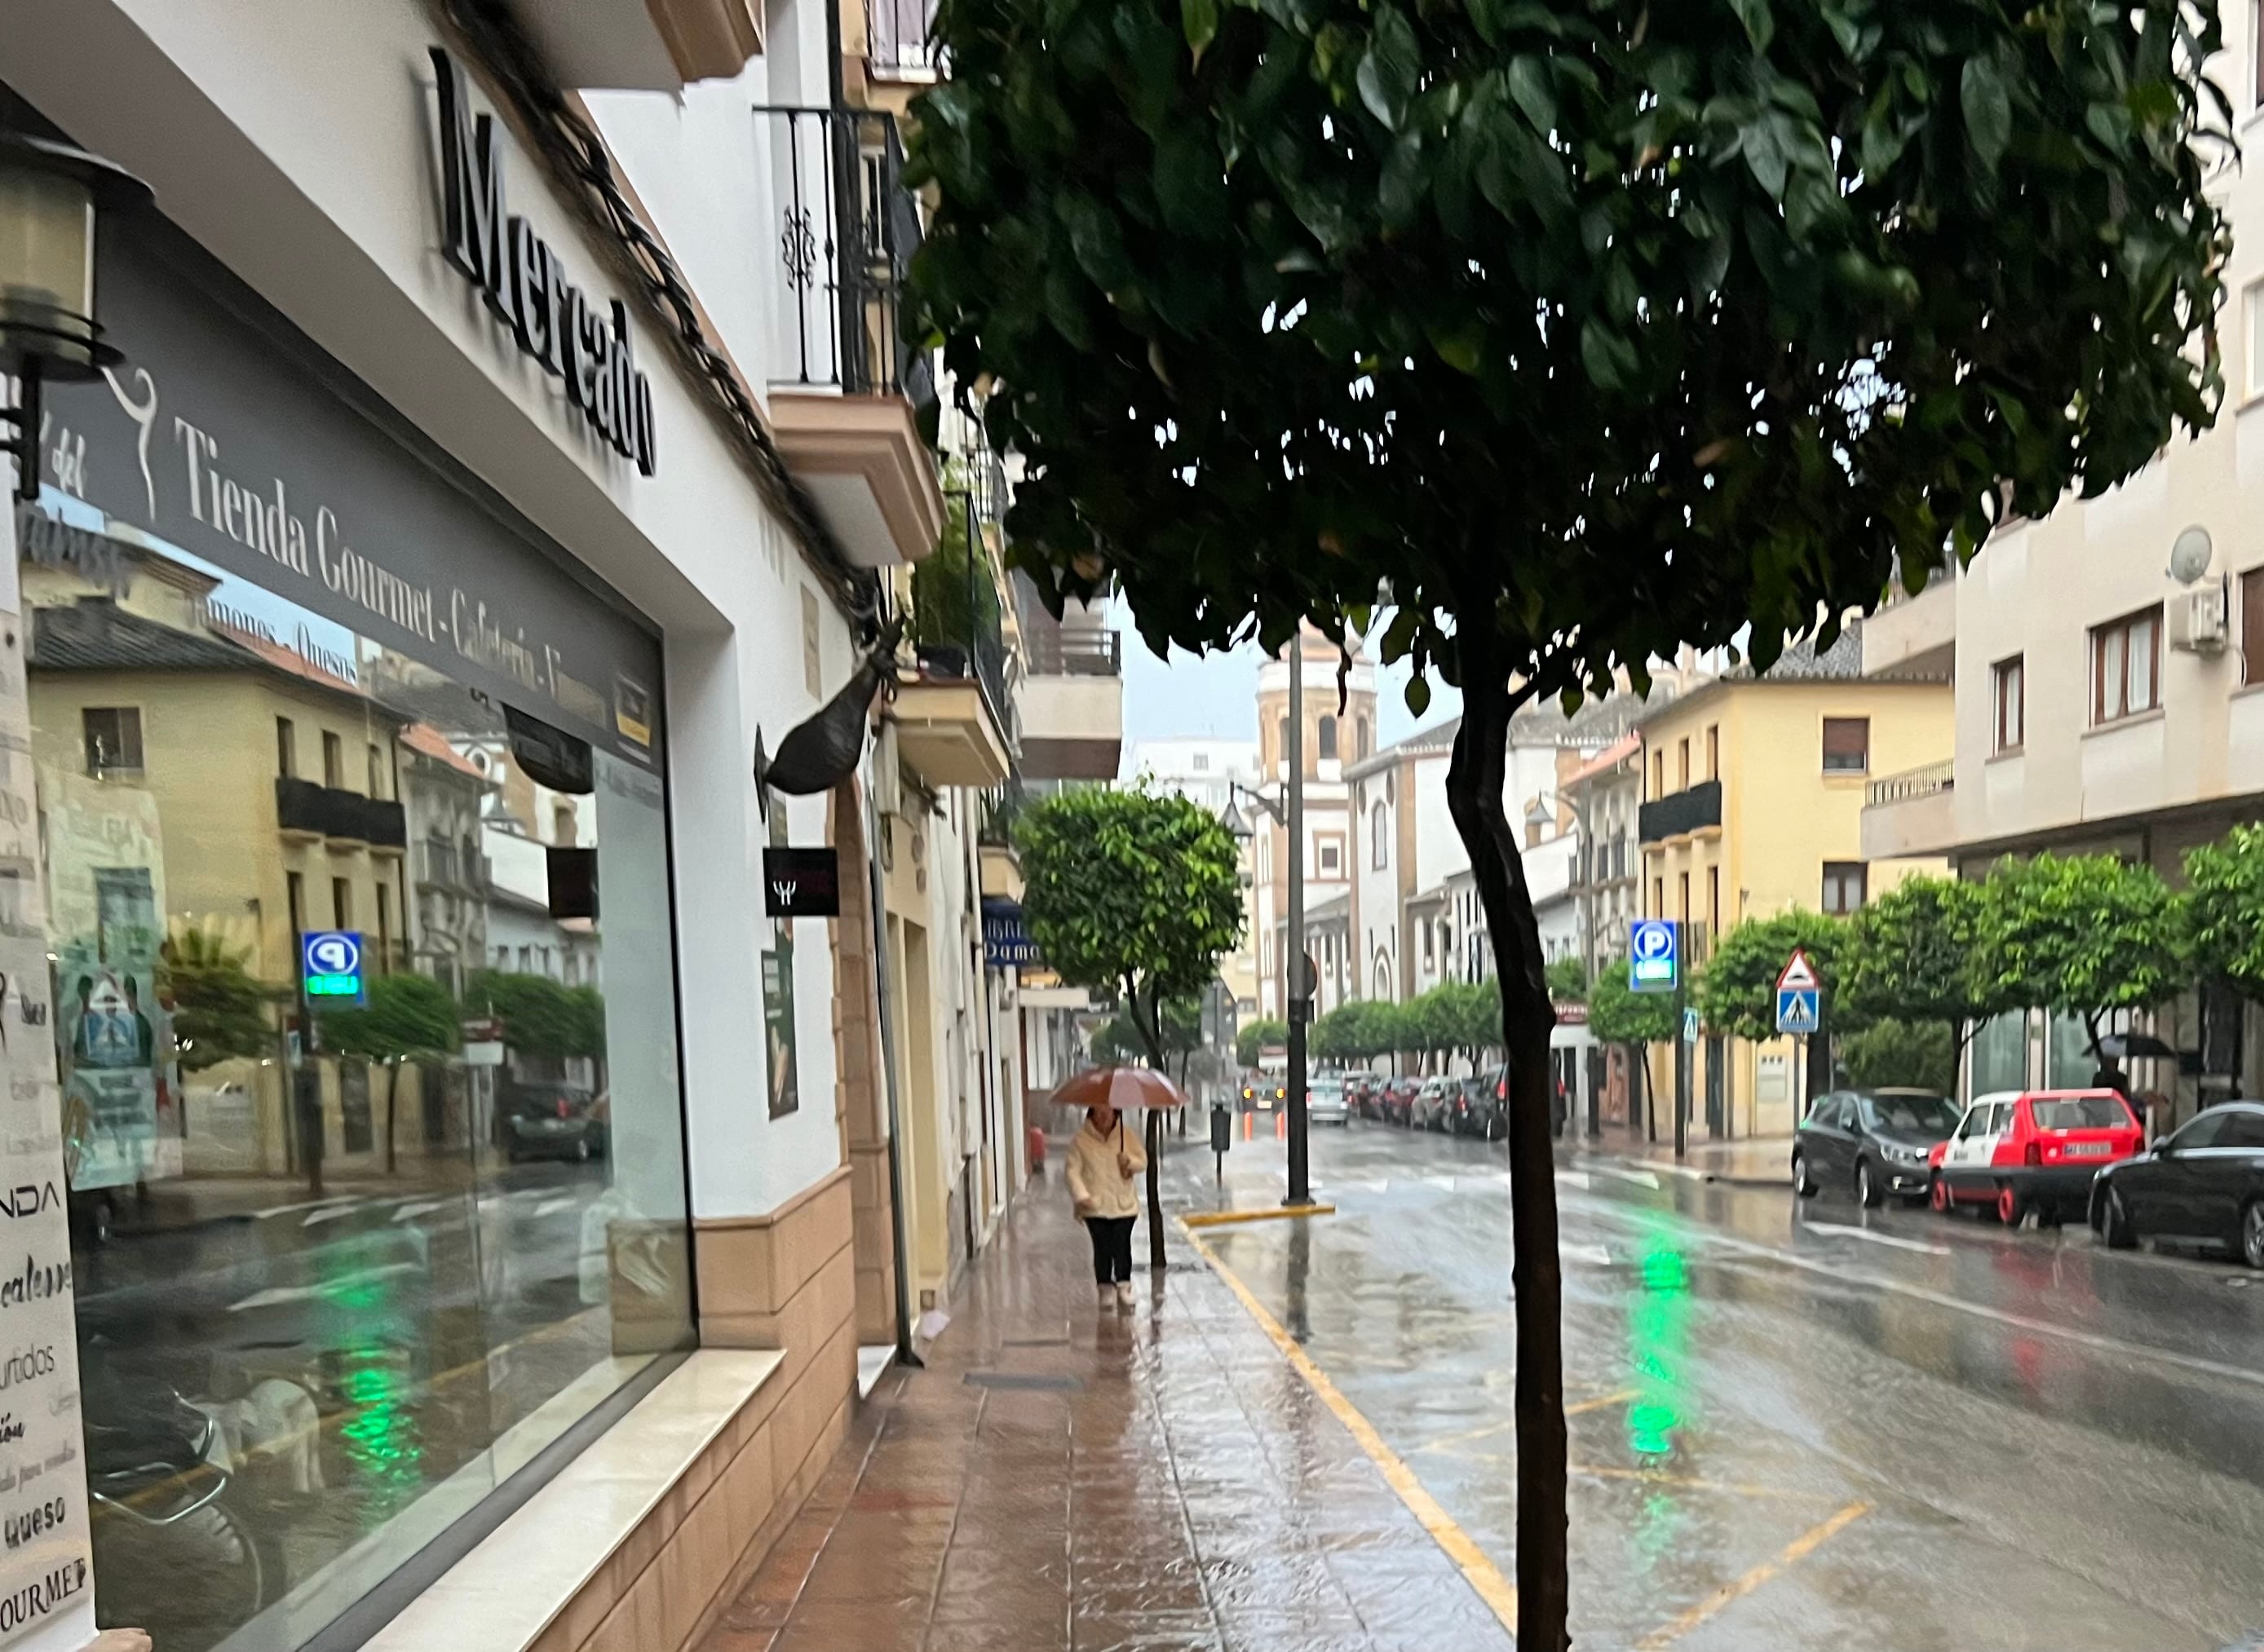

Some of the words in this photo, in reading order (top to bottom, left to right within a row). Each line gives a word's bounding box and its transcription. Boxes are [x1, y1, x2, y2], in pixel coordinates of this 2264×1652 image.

[428, 46, 655, 477] Mercado
[174, 416, 310, 578] Tienda
[316, 506, 436, 644] Gourmet
[1644, 931, 1666, 956] P
